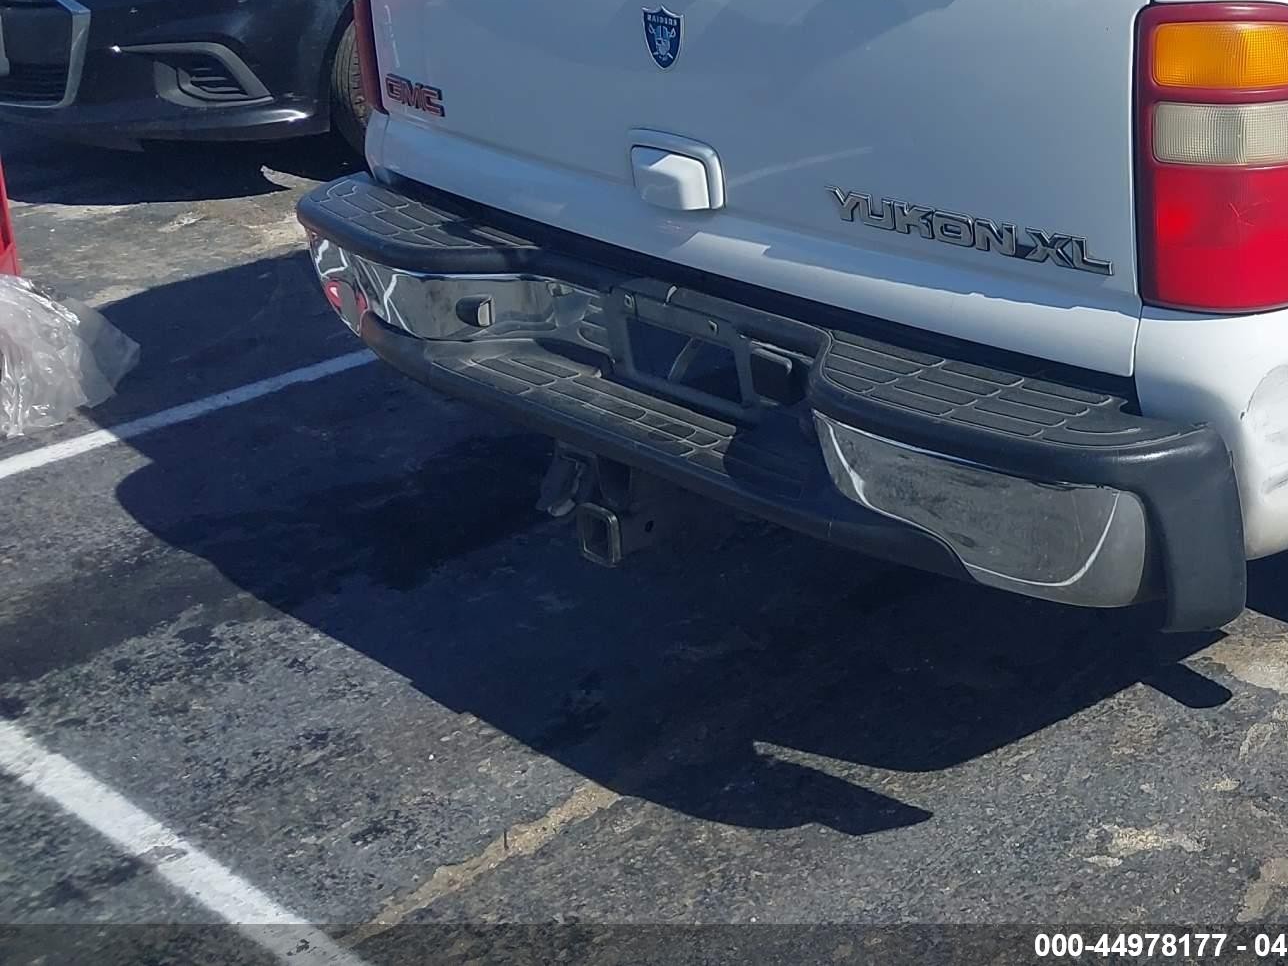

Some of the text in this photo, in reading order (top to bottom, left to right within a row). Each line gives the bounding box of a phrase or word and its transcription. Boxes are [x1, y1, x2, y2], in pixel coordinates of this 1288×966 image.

[647, 14, 677, 26] RAIDERS
[385, 73, 446, 117] GMC
[827, 185, 1115, 276] YUKON XL
